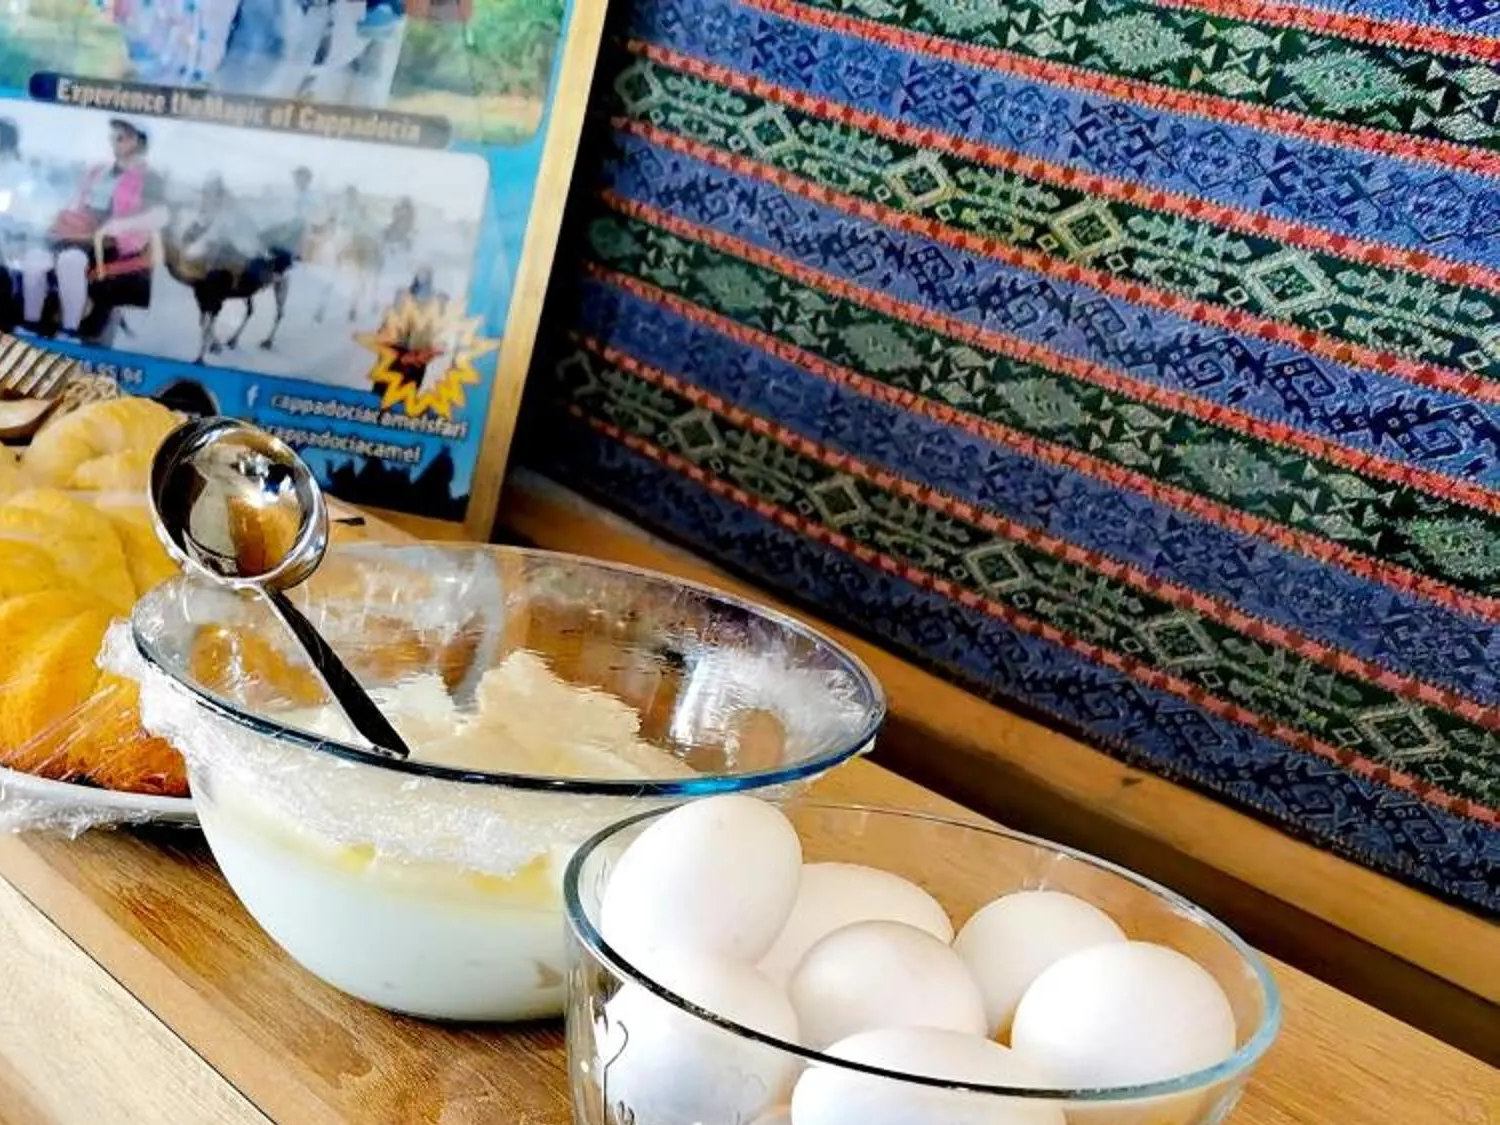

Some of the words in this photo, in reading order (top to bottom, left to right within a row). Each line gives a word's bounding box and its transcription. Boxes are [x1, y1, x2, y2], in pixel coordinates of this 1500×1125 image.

[56, 77, 166, 115] Experience
[172, 90, 203, 117] the
[203, 94, 264, 128] Magic
[270, 102, 295, 127] of
[298, 105, 422, 146] Cappadocia
